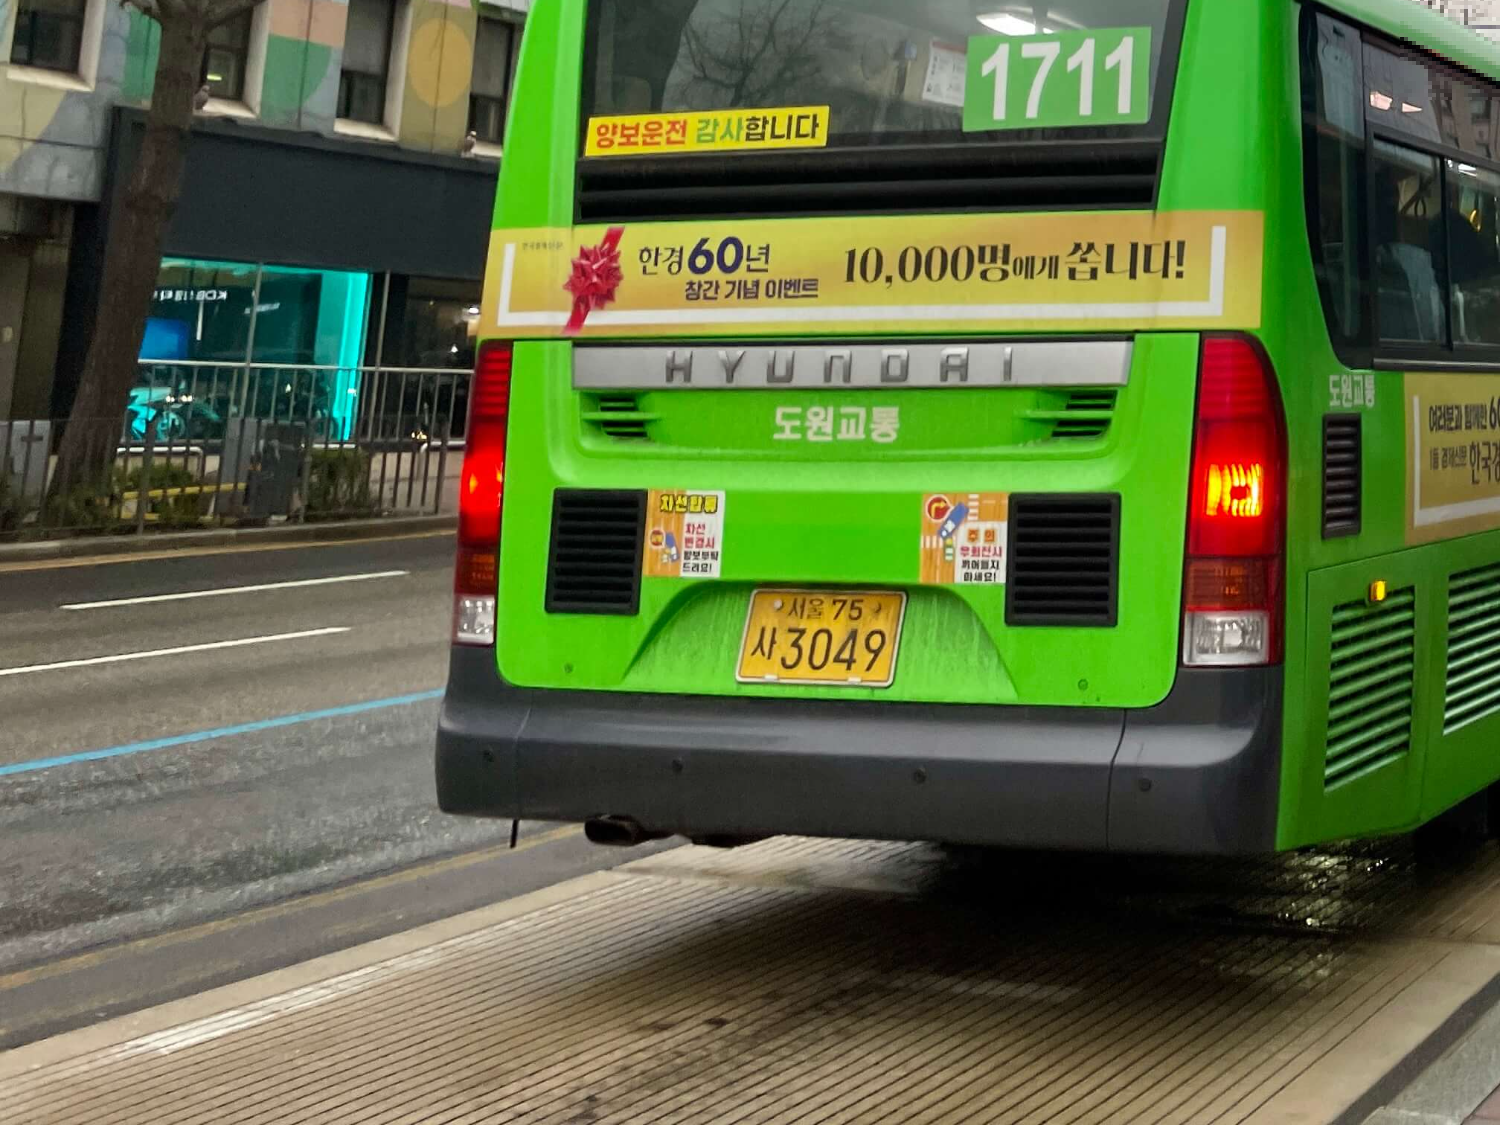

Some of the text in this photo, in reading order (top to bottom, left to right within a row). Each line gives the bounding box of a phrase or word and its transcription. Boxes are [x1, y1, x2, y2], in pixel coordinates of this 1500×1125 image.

[980, 35, 1134, 120] 1711
[595, 113, 820, 148] 양보운전 감사합니다
[639, 236, 770, 276] 한경60년
[845, 240, 1187, 289] 10,000명에게 쏩니다!
[685, 277, 819, 301] 창간 기념 이벤트
[664, 346, 1013, 384] HYUNDAI
[1328, 374, 1376, 409] 도원교통
[773, 406, 900, 442] 도원교통
[1429, 403, 1462, 432] 여러분과
[685, 523, 706, 535] 차선
[787, 597, 863, 622] 서울 75
